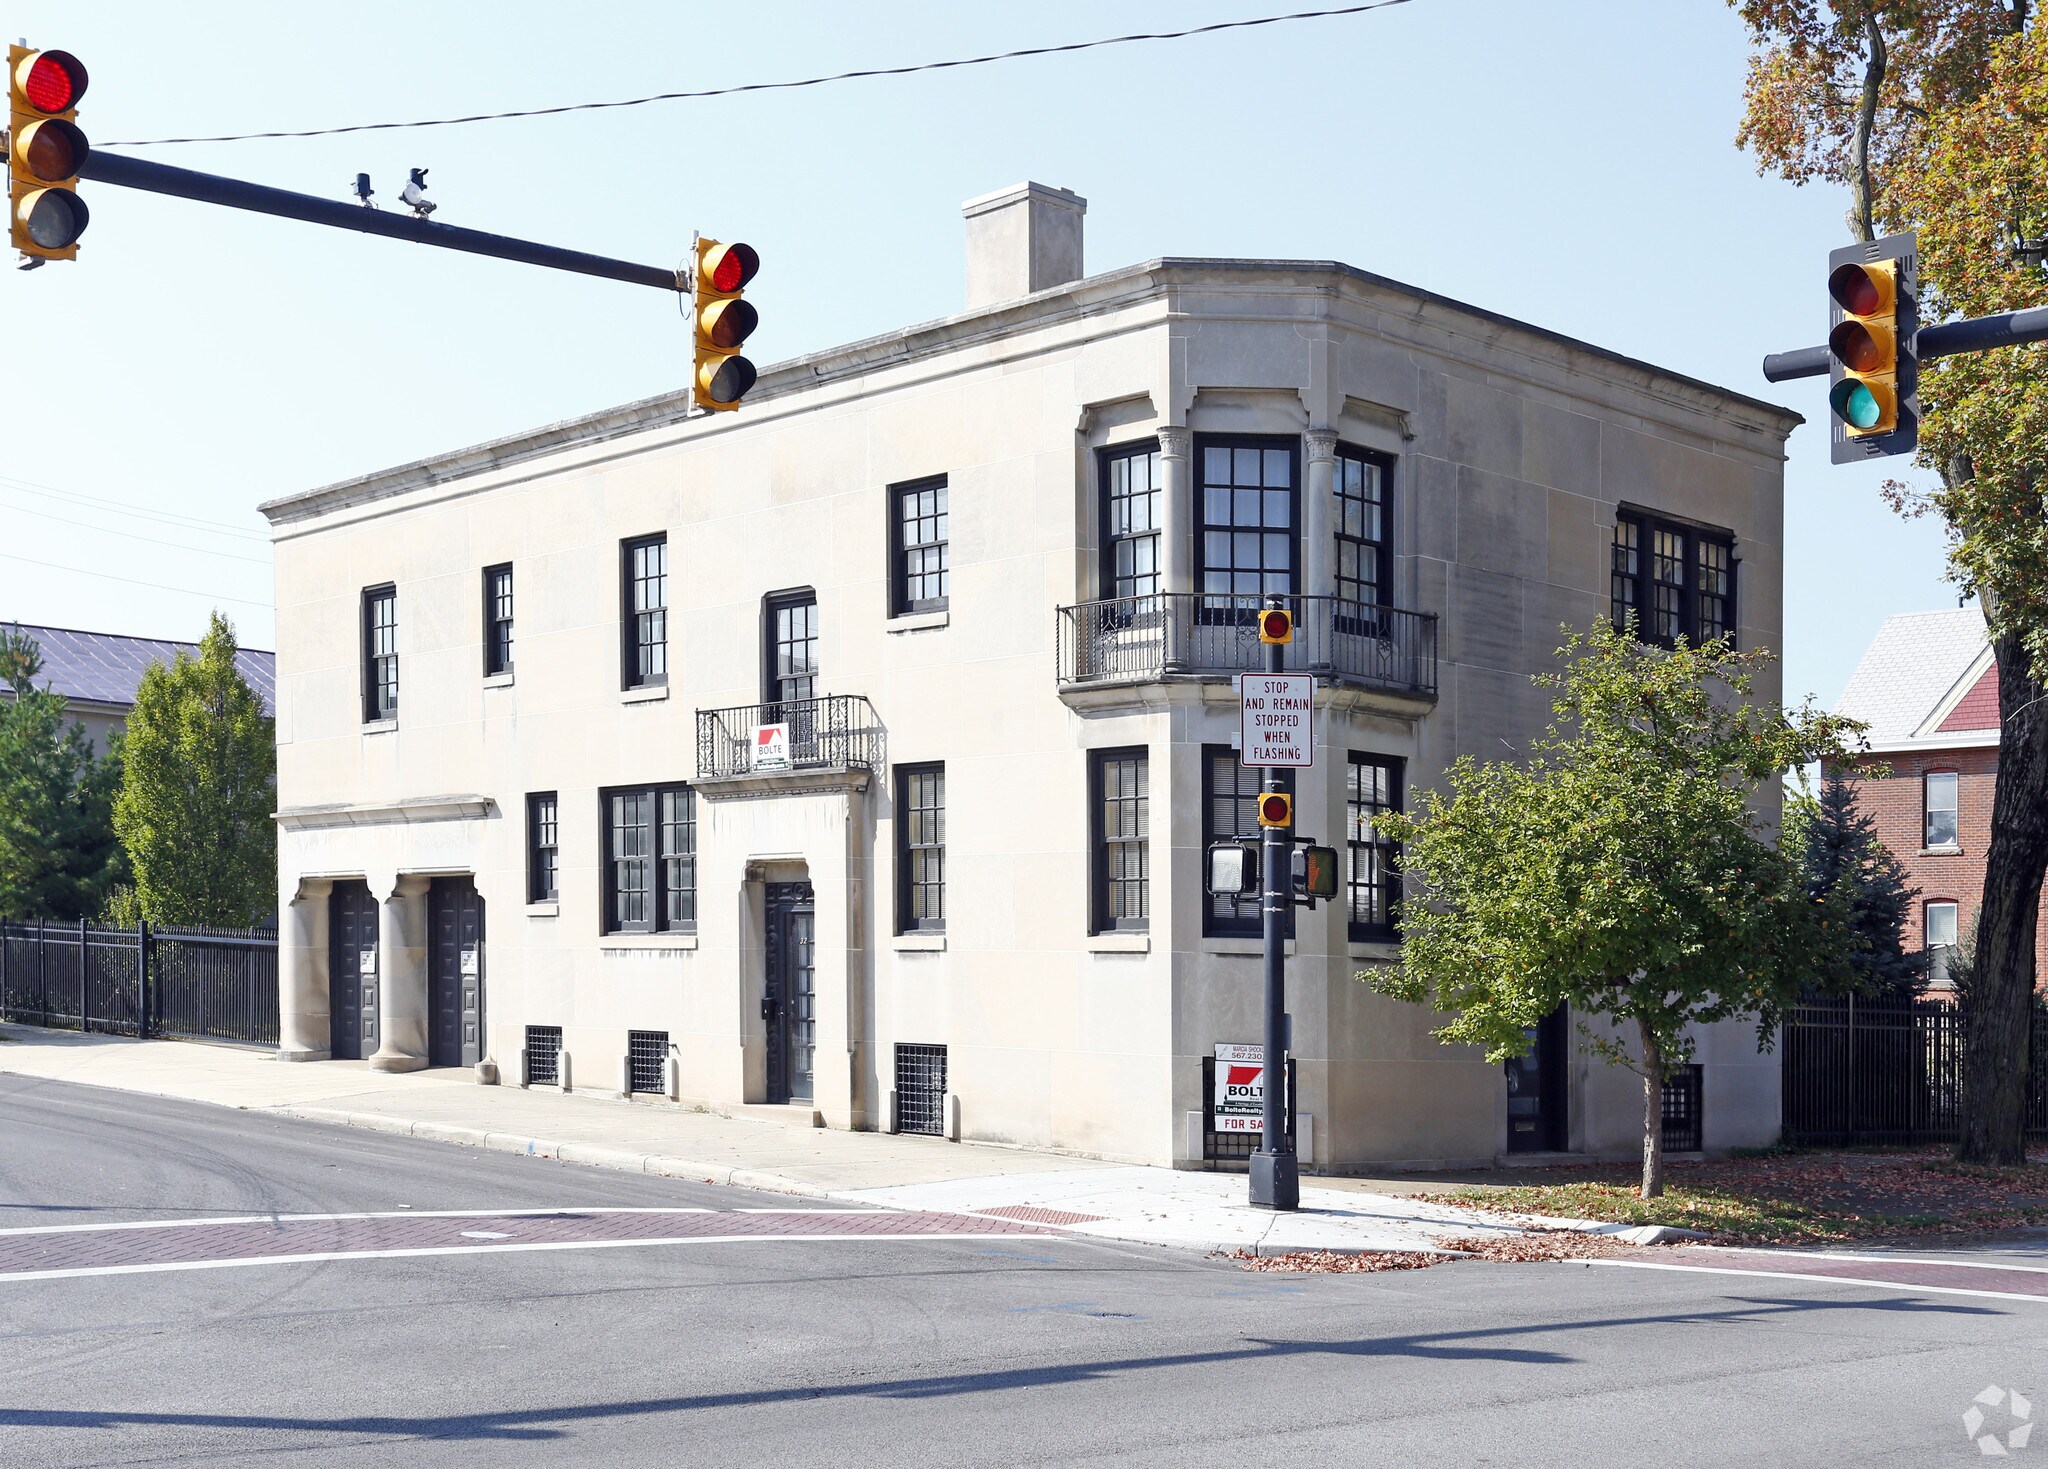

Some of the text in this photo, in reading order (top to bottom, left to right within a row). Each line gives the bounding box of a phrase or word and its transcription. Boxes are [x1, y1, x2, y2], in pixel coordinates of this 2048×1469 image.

[1264, 681, 1289, 694] STOP
[1245, 698, 1309, 711] AND REMAIN
[1255, 714, 1299, 727] STOPPED
[1264, 731, 1291, 743] WHEN
[758, 744, 782, 755] BOLTE
[1254, 747, 1301, 760] FLASHING
[1231, 1052, 1264, 1060] 567.230.
[1228, 1086, 1264, 1097] BOLT
[1224, 1106, 1264, 1115] BolteRealty.
[1224, 1118, 1264, 1130] FOR SA
